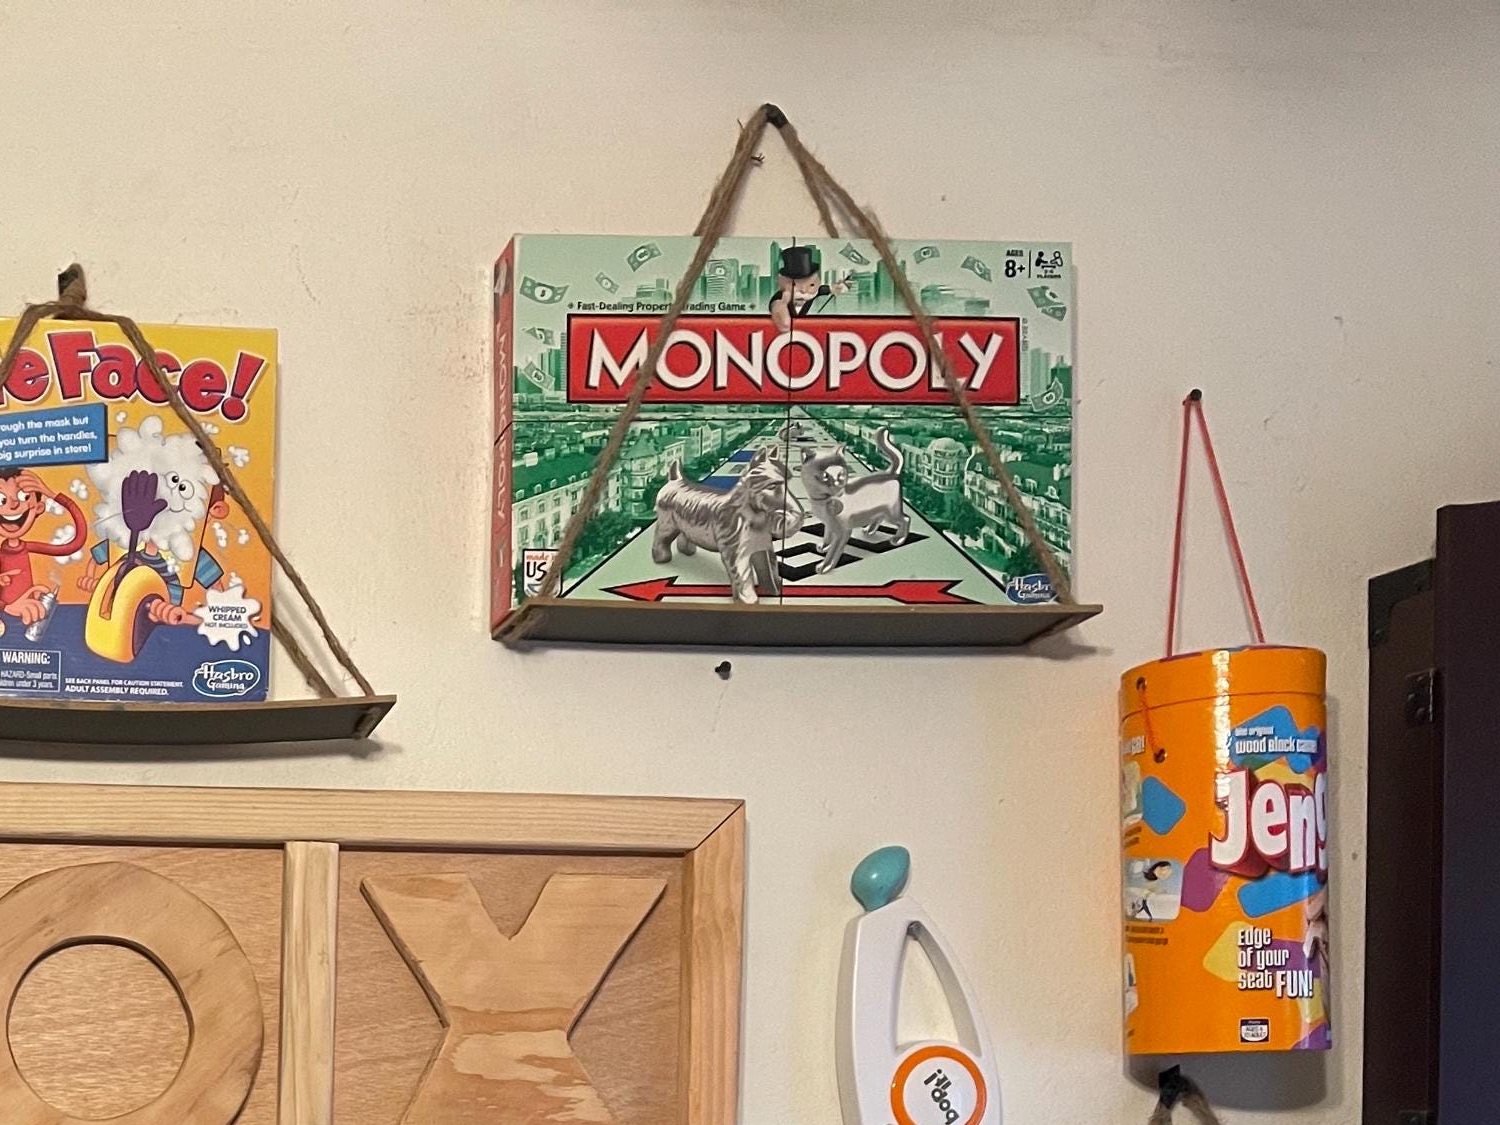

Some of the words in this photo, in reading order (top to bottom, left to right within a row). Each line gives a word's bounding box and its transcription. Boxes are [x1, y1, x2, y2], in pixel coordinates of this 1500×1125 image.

[1006, 249, 1024, 257] AGES
[1004, 259, 1026, 278] 8+
[576, 302, 634, 312] Fast-Dealing
[718, 302, 746, 311] Game
[585, 327, 1003, 393] MONOPOLY
[46, 329, 266, 422] Face!
[27, 419, 43, 430] the
[45, 416, 71, 428] mask
[73, 415, 89, 426] but
[18, 434, 38, 445] turn
[39, 432, 55, 443] the
[14, 446, 52, 460] surprise
[53, 445, 63, 455] in
[64, 442, 92, 454] store!
[208, 605, 247, 614] WHIPPED
[212, 614, 242, 622] CREAM
[2, 650, 51, 665] WARNING:
[203, 664, 255, 682] Hasbro
[65, 685, 90, 694] ADULT
[90, 686, 128, 695] ASSEMBLY
[207, 680, 246, 692] Gaming
[1235, 738, 1266, 754] wood
[1238, 926, 1272, 949] Edge
[1238, 947, 1254, 968] of
[1256, 949, 1289, 970] your
[1238, 969, 1273, 990] seat
[1275, 970, 1314, 998] FUN!
